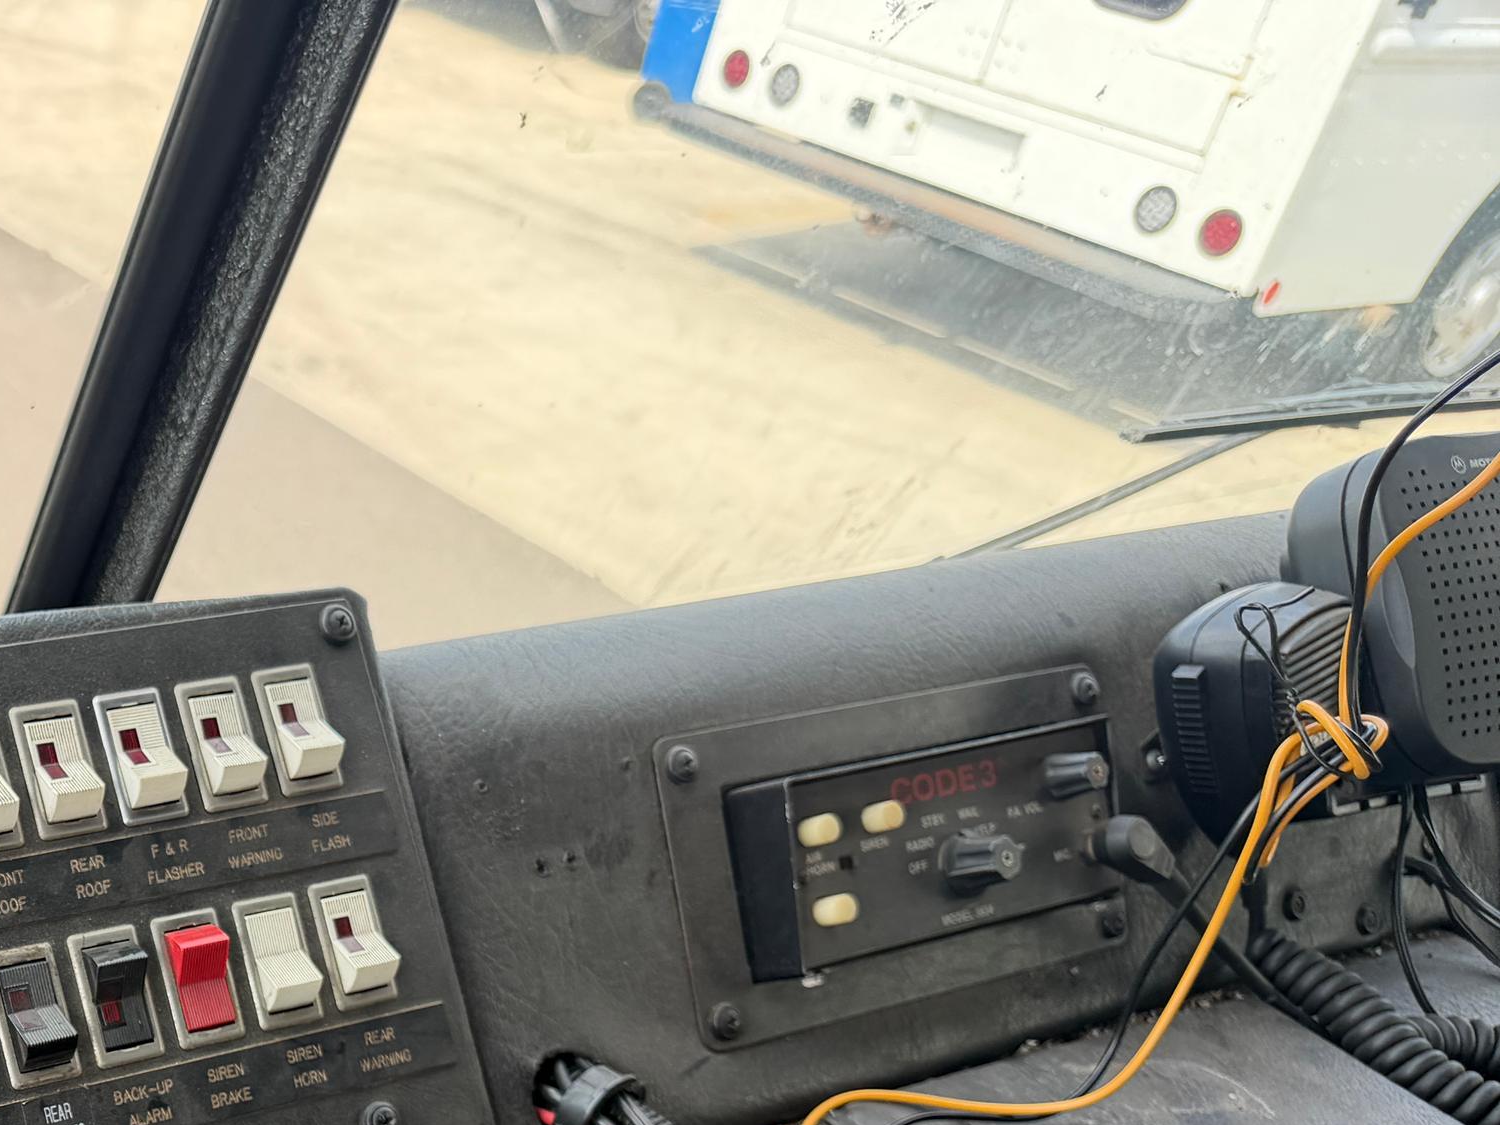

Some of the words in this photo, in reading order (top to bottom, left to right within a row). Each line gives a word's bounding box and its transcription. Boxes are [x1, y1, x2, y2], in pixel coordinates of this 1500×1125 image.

[311, 811, 339, 828] SIDE
[228, 823, 268, 844] FRONT
[311, 834, 351, 853] FLASH
[150, 844, 159, 859] F
[165, 843, 176, 856] &
[179, 839, 189, 853] R
[228, 847, 283, 869] WARNING
[69, 854, 106, 874] REAR
[147, 861, 205, 885] FLASHER
[75, 879, 112, 900] ROOF
[363, 1027, 396, 1046] REAR
[285, 1043, 324, 1065] SIREN
[359, 1048, 412, 1072] WARNING
[207, 1062, 245, 1083] SIREN
[293, 1069, 329, 1089] HORN
[113, 1078, 174, 1106] BACK-UP
[210, 1086, 253, 1109] BRAKE
[43, 1102, 73, 1124] REAR
